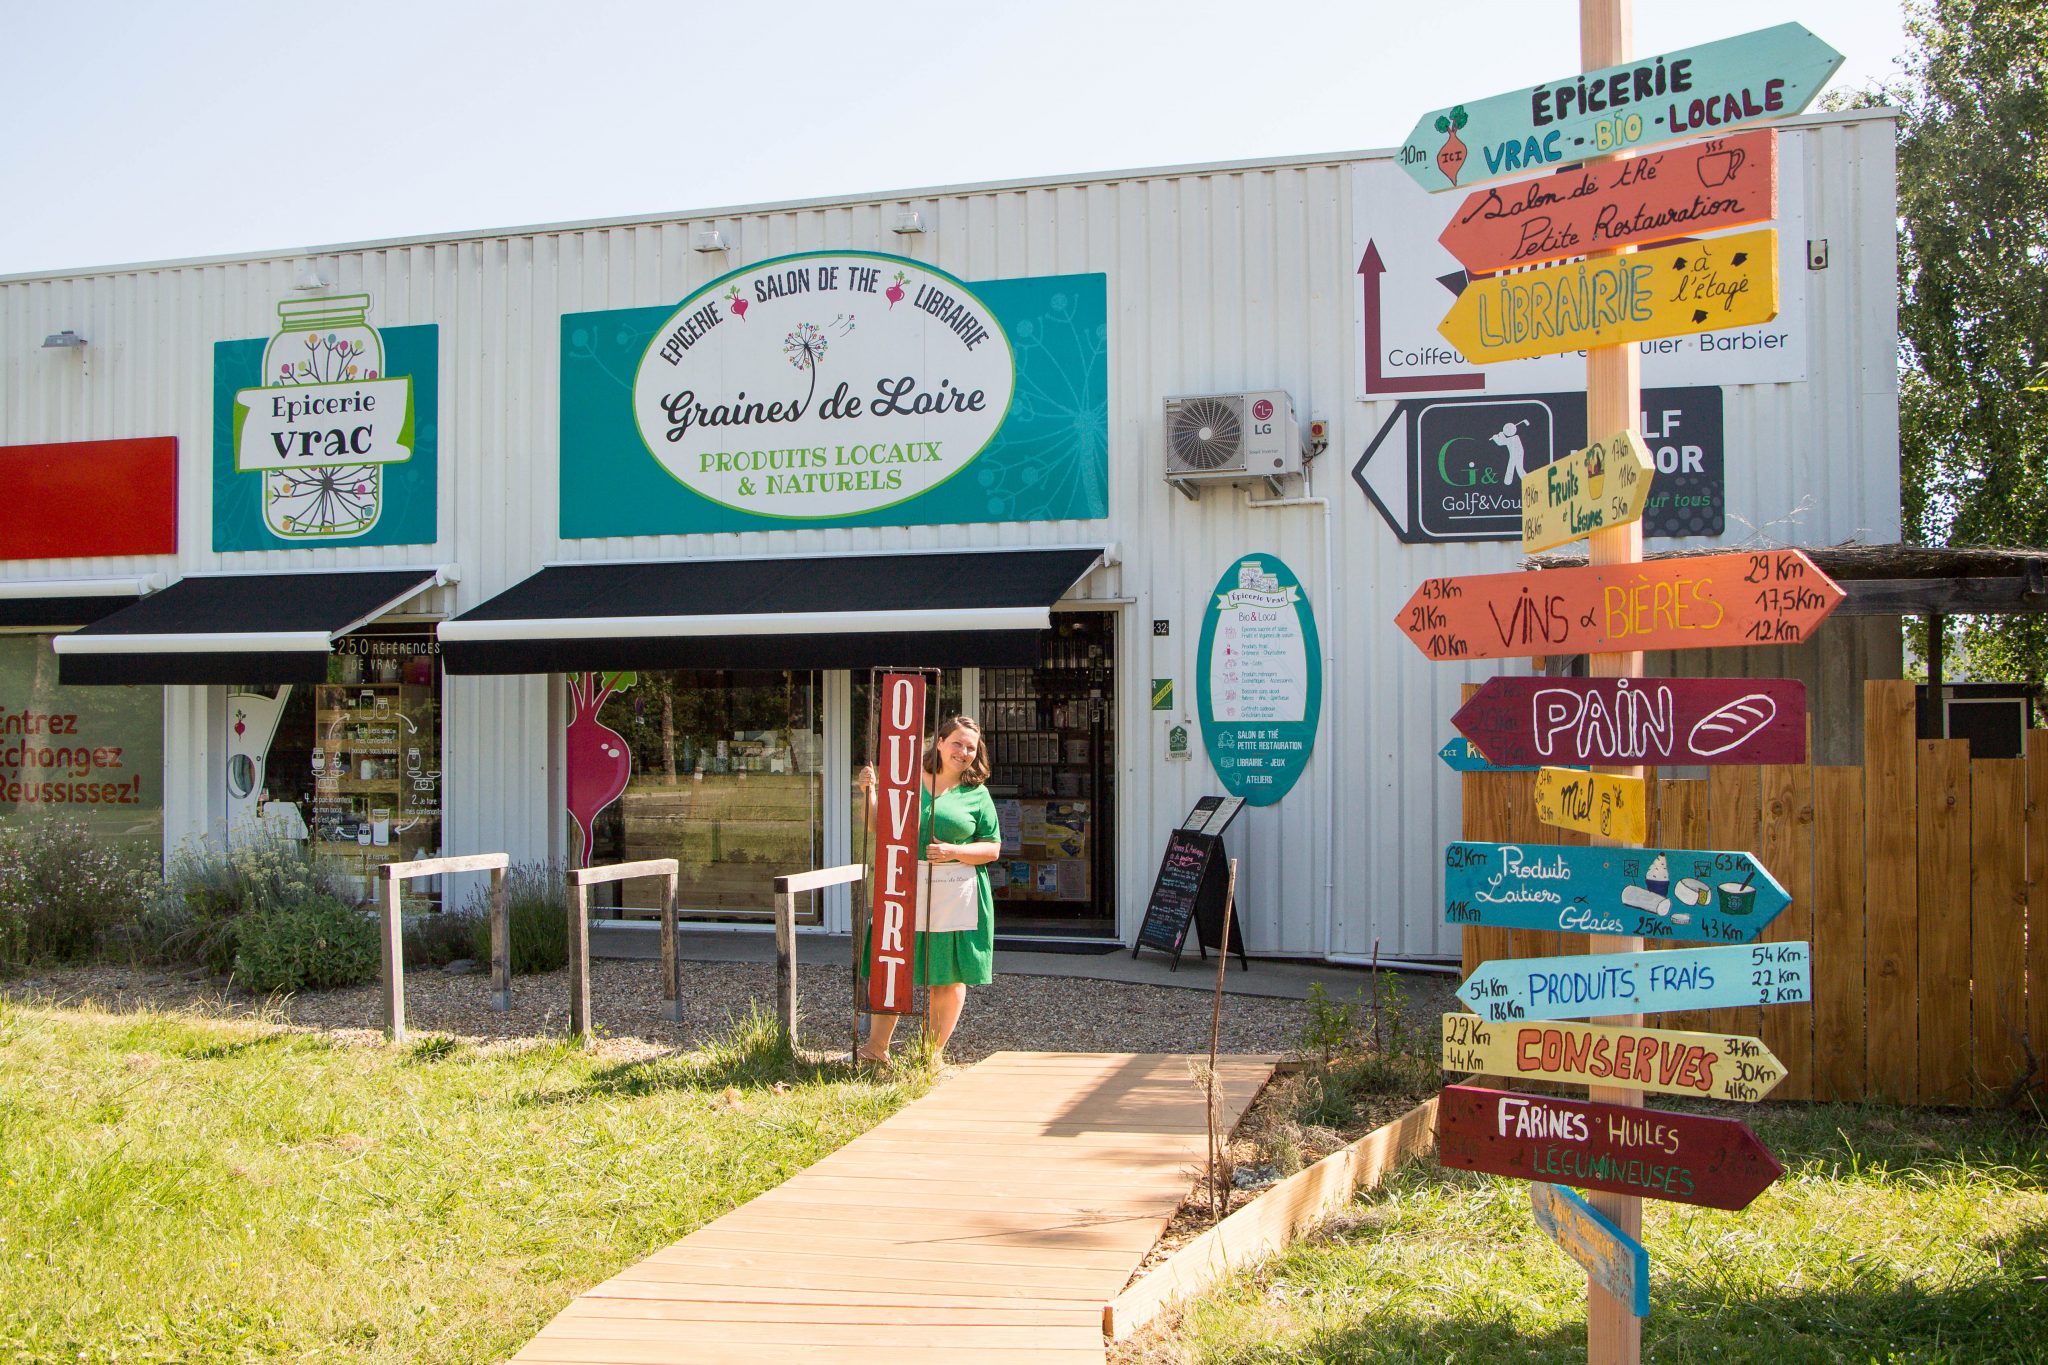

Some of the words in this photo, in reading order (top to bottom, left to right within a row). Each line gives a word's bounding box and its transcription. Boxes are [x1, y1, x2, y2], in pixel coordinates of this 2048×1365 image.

[1442, 151, 1463, 163] ICI
[1483, 130, 1562, 174] VRAC
[1462, 187, 1565, 224] Salon
[1609, 155, 1664, 192] thé
[1509, 216, 1580, 260] Petite
[1592, 195, 1745, 242] Restauration
[1691, 245, 1712, 273] à
[753, 266, 812, 303] SALON
[817, 266, 840, 292] DE
[848, 266, 882, 294] THE
[658, 300, 725, 367] EPICERIE
[912, 283, 991, 353] LIBRAIRIE
[1388, 347, 1471, 367] Coiffeu
[1700, 330, 1788, 352] Barbier
[272, 390, 376, 423] Epicerie
[660, 391, 803, 442] Graines
[818, 382, 863, 420] de
[870, 376, 987, 417] Loire
[1254, 424, 1272, 435] LG
[1641, 410, 1682, 438] LF
[271, 424, 373, 459] vrac
[699, 446, 828, 473] PRODUITS
[834, 441, 943, 467] LOCAUX
[737, 475, 758, 497] &
[764, 469, 903, 496] NATURELS
[1547, 462, 1579, 508] Fruits
[1442, 493, 1523, 515] Golf&Vou
[1674, 493, 1711, 508] tous
[1570, 501, 1603, 535] Légumes
[1604, 574, 1724, 640] BIÈRES
[1155, 622, 1167, 634] 32
[338, 638, 369, 655] 250
[351, 659, 364, 671] DE
[370, 658, 398, 670] VRAC
[1237, 730, 1256, 739] SALON
[1258, 730, 1266, 739] DE
[1268, 728, 1279, 739] THÉ
[1237, 741, 1257, 750] PETITE
[1258, 741, 1302, 750] RESTAURATION
[1236, 758, 1263, 767] LIBRAIRIE
[1270, 758, 1286, 767] JEUX
[1246, 775, 1273, 784] ATELIERS
[1561, 777, 1594, 822] Miel
[877, 678, 918, 1009] OUVERT
[1497, 845, 1571, 877] Produits
[1475, 873, 1562, 904] Laitiers
[1558, 906, 1624, 932] Glaces
[1528, 965, 1636, 1007] PRODUITS
[1649, 961, 1715, 992] FRAIS
[1516, 1028, 1719, 1092] CONSERVES
[1498, 1097, 1589, 1142] FARINES
[1608, 1113, 1679, 1155] HUILES
